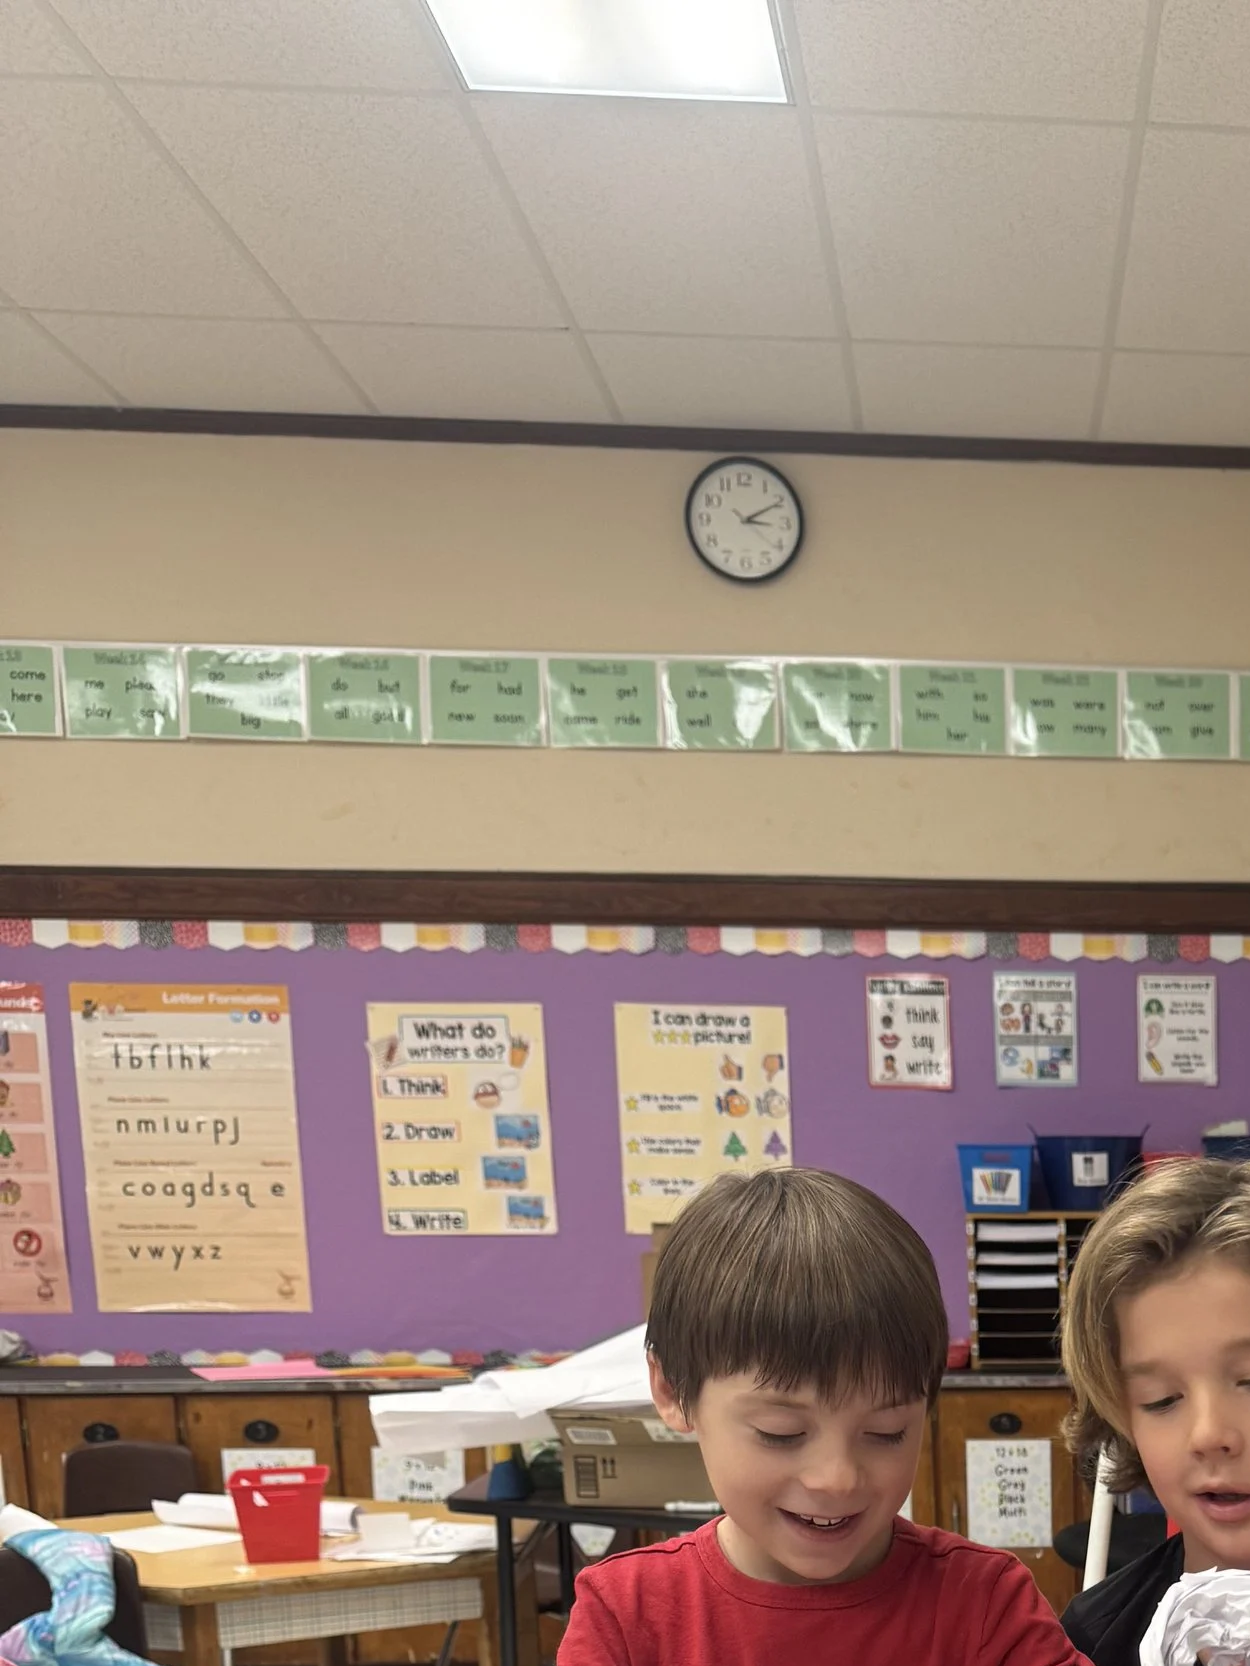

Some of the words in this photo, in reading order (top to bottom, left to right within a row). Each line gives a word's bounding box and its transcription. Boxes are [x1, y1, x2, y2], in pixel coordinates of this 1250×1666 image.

[719, 476, 732, 492] 11
[736, 472, 753, 488] 12
[762, 479, 768, 495] 1
[704, 493, 722, 508] 10
[773, 494, 785, 508] 2
[698, 512, 711, 526] 9
[779, 516, 792, 531] 3
[706, 533, 718, 547] 8
[773, 537, 784, 552] 4
[722, 549, 733, 564] 7
[739, 555, 752, 570] 6
[162, 991, 205, 1005] Letter
[208, 992, 281, 1006] Formation
[652, 1009, 661, 1025] I
[663, 1012, 692, 1026] can
[695, 1012, 737, 1027] draw
[906, 1007, 940, 1024] think
[412, 1021, 464, 1040] What
[471, 1021, 496, 1040] do
[407, 1044, 471, 1060] writers
[475, 1043, 506, 1059] do?
[911, 1034, 935, 1054] say
[906, 1059, 942, 1075] write
[398, 1079, 443, 1096] Think
[404, 1122, 455, 1140] Draw
[408, 1169, 459, 1187] Label
[411, 1212, 461, 1230] Write
[995, 1464, 1028, 1477] Green
